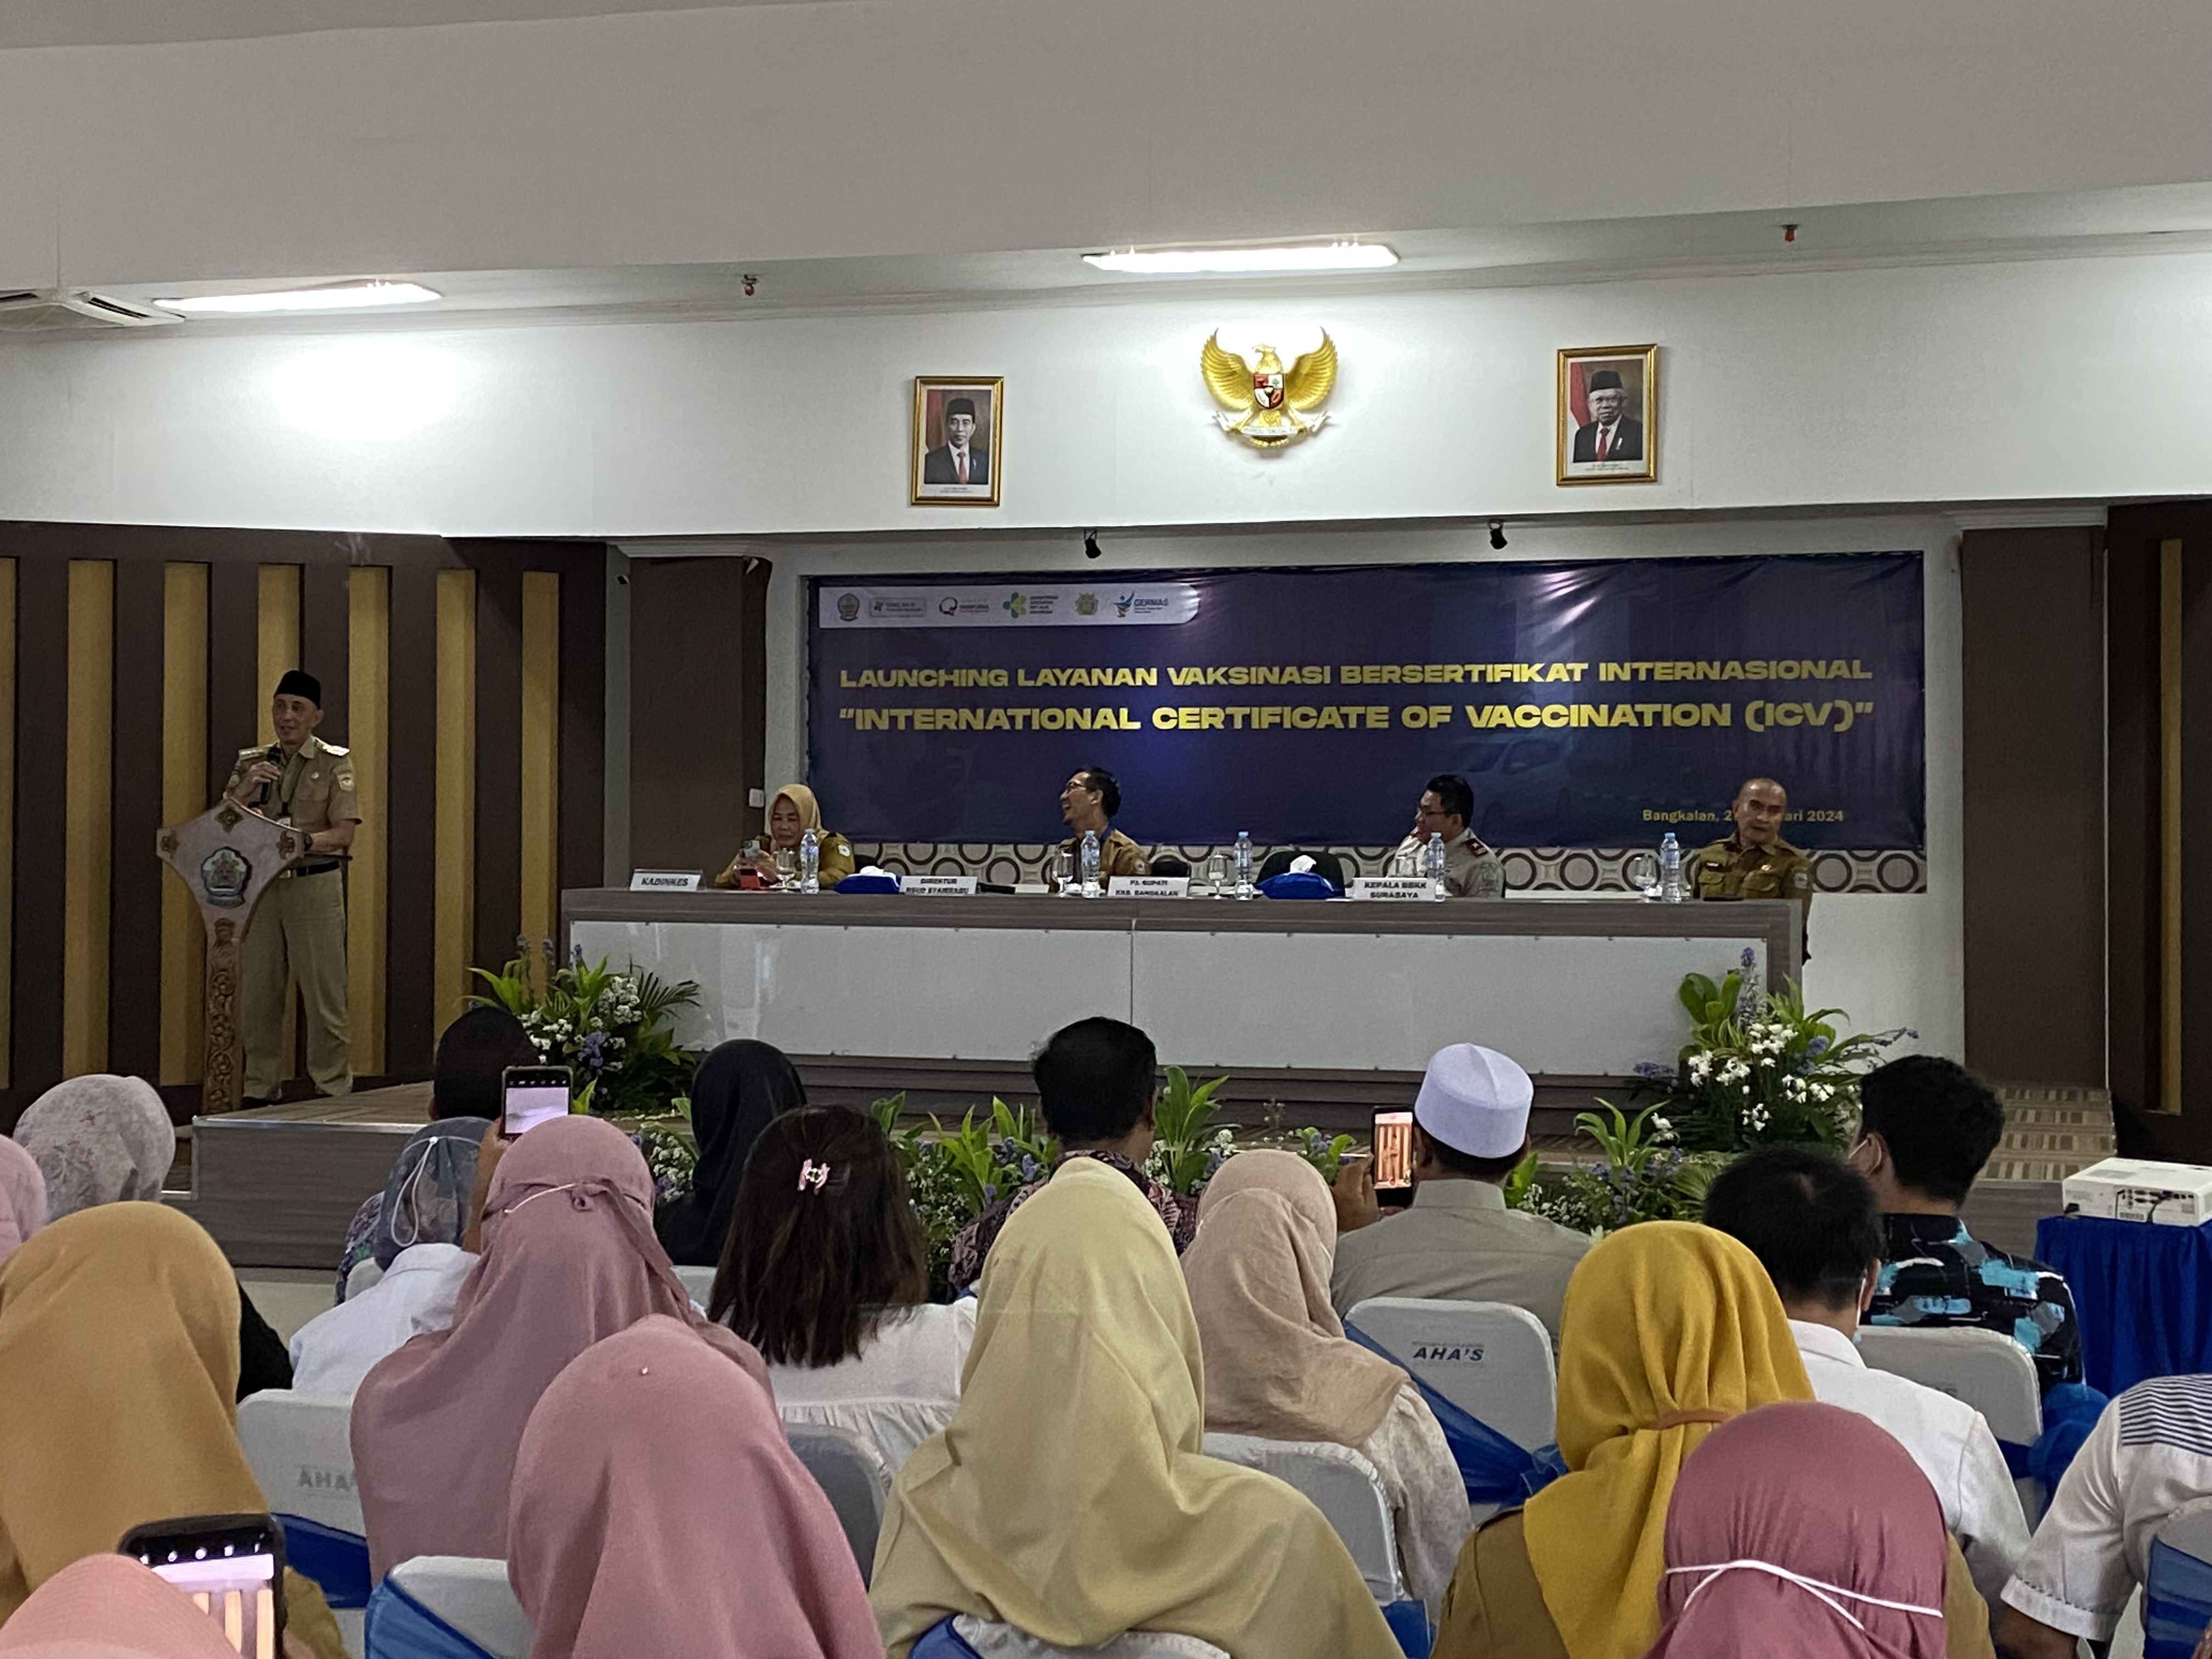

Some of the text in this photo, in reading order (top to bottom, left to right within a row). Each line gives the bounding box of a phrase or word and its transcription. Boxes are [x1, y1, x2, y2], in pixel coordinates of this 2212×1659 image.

[840, 660, 1872, 687] LAUNCHING LAYANAN VAKSINASI BERSERTIFIKAT INTERNASIONAL
[1151, 706, 1389, 730] CERTIFICATE
[1401, 705, 1452, 729] OF
[1465, 703, 1731, 728] VACCINATION
[1643, 810, 1719, 823] Bangkalan,
[1807, 810, 1844, 821] 2024
[1413, 1347, 1483, 1361] AHA'S
[300, 1470, 356, 1492] AHA
